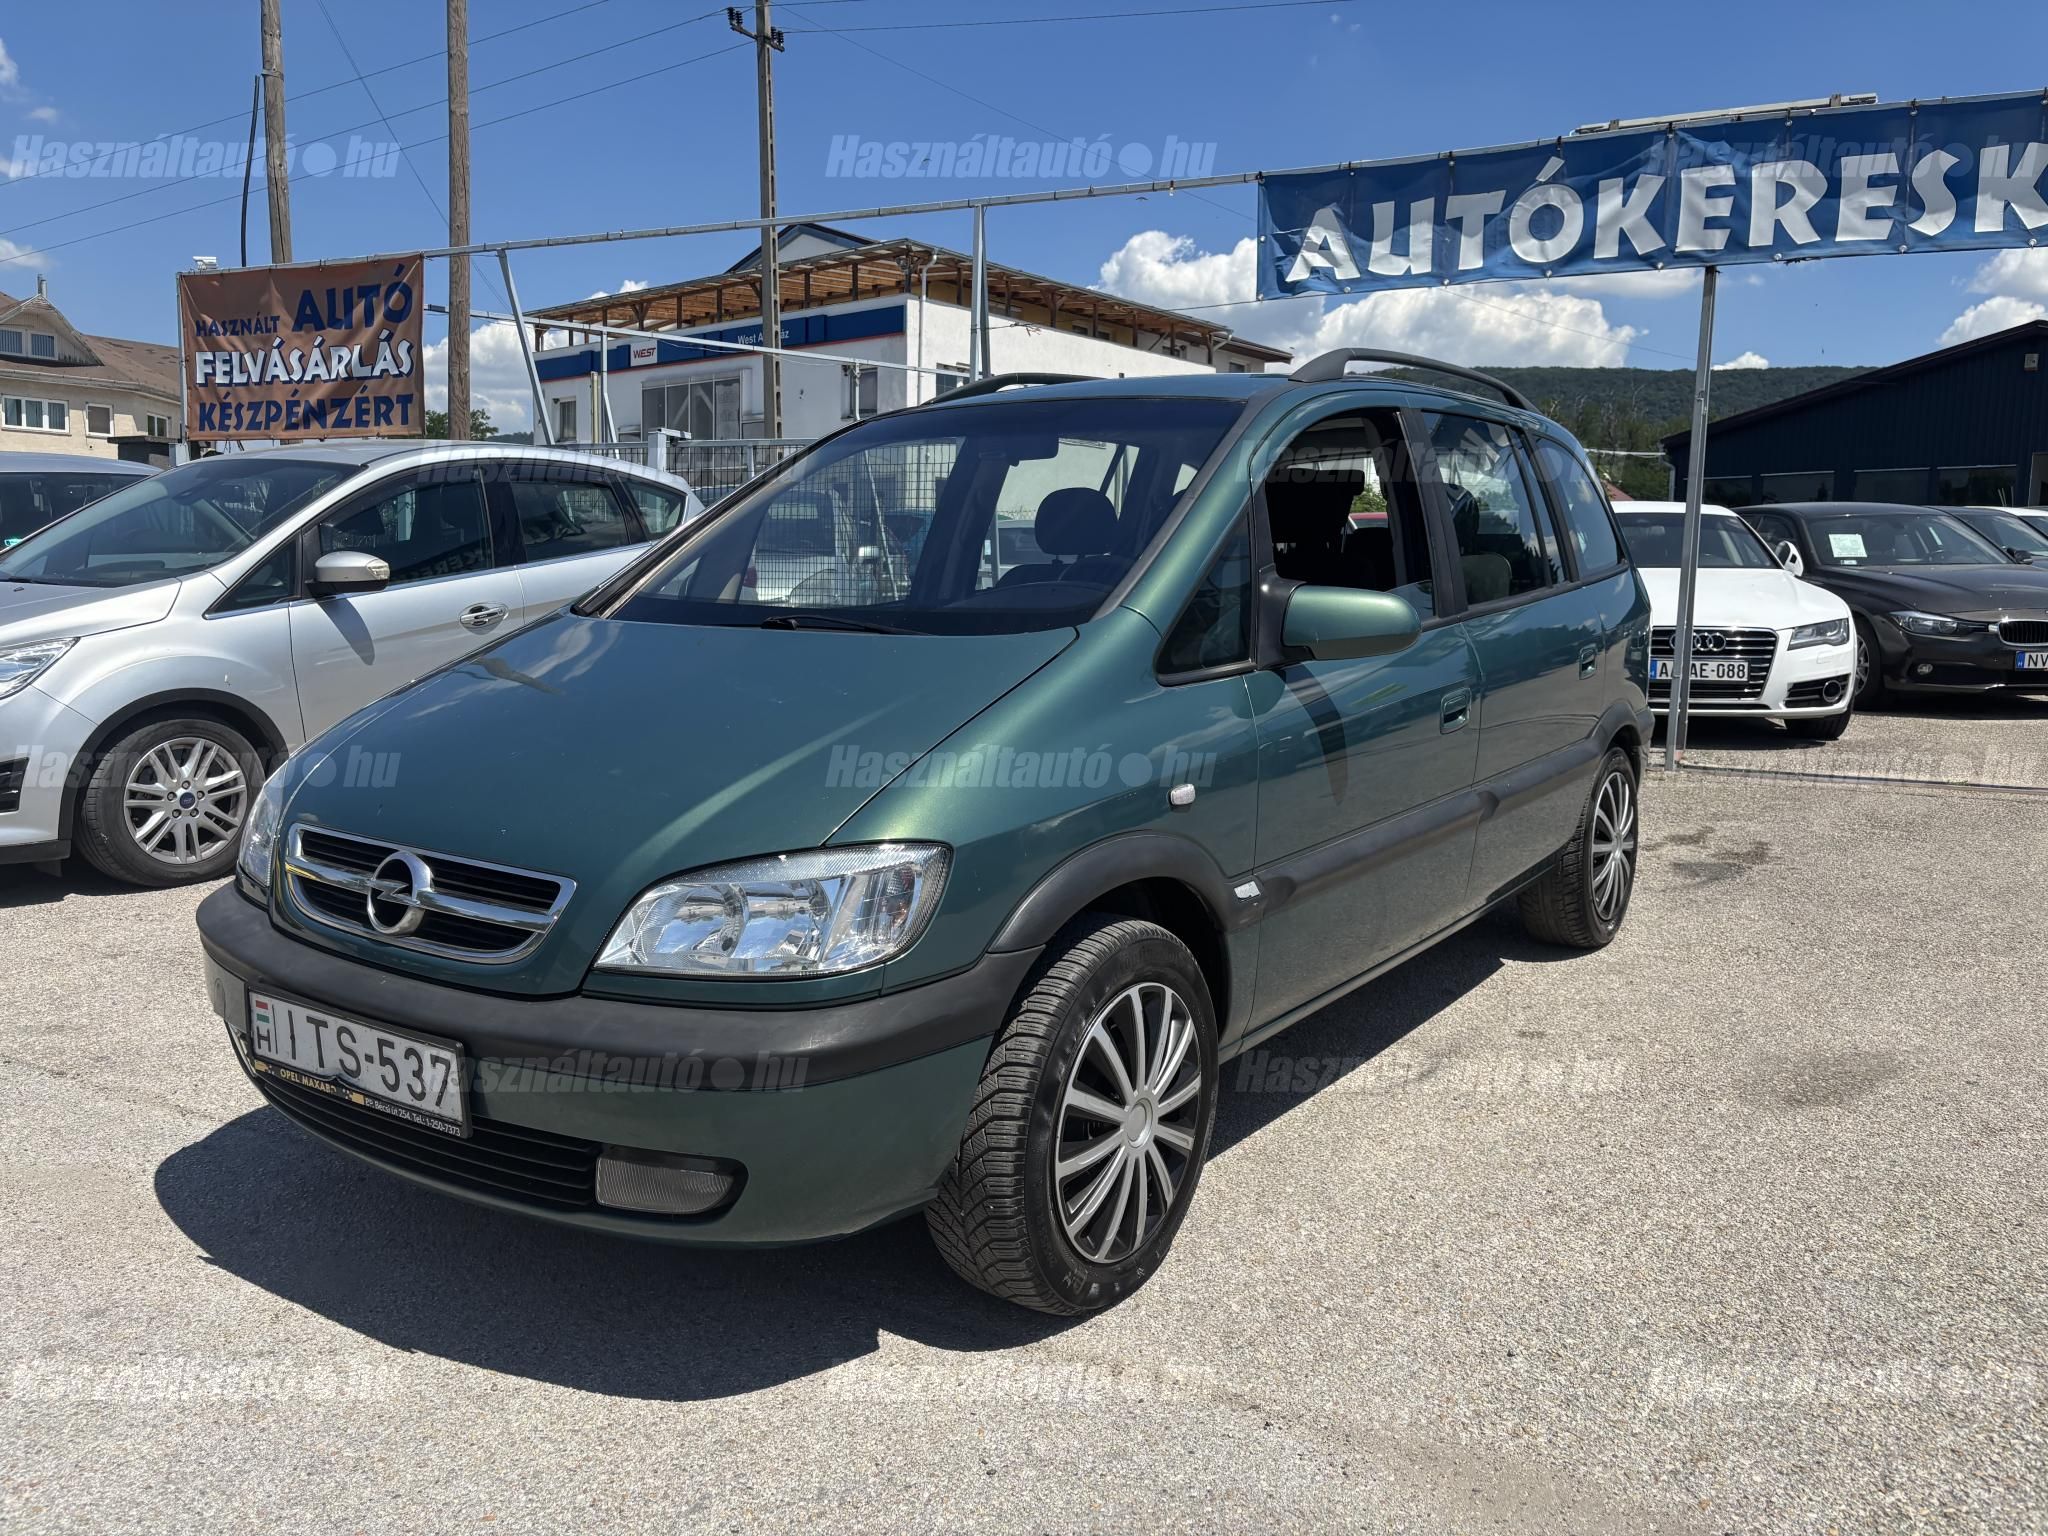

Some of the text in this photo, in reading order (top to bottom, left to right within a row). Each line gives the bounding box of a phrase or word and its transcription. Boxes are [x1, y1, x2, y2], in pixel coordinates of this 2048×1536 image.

[1285, 141, 2048, 283] AUTÓKERESK
[195, 263, 413, 337] HASZNÁLT AUTÓ
[195, 328, 415, 388] FELVÁSÁRLÁS
[632, 346, 657, 359] WEST
[737, 333, 758, 345] West
[198, 384, 414, 433] KÉSZPÉNZÉRT
[256, 1009, 451, 1108] H ITS-537
[280, 1068, 301, 1083] OPEL
